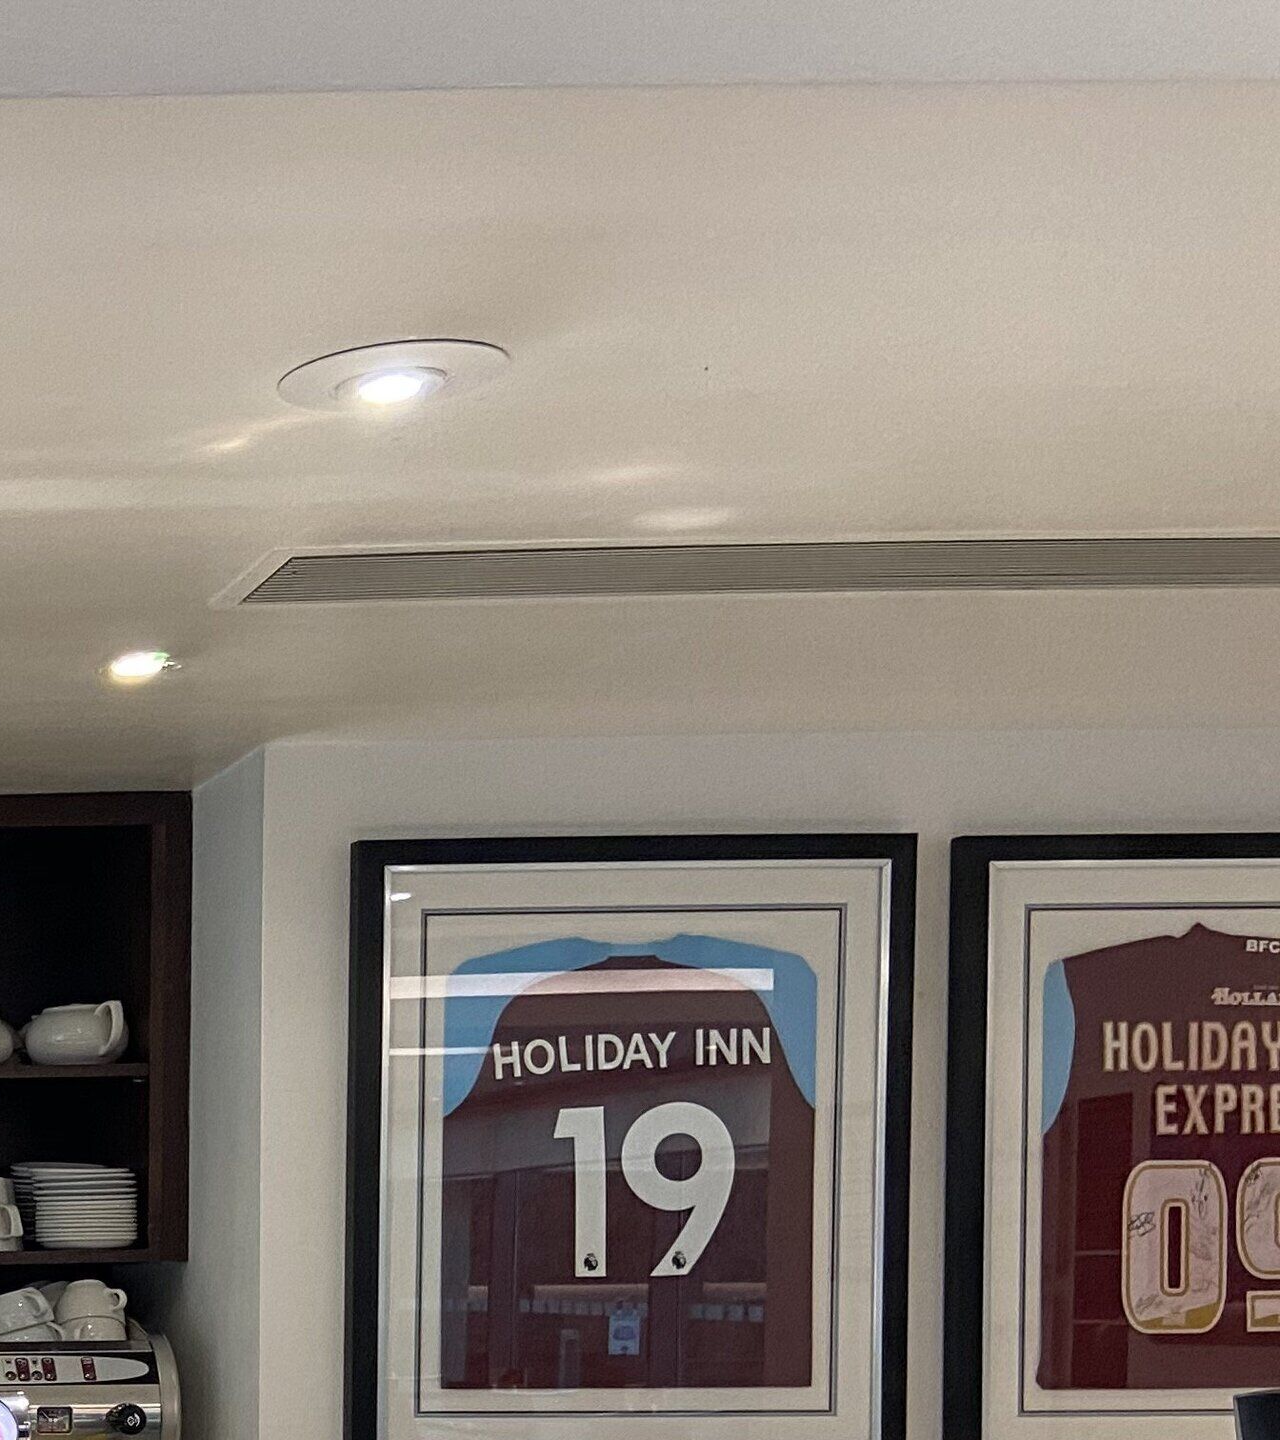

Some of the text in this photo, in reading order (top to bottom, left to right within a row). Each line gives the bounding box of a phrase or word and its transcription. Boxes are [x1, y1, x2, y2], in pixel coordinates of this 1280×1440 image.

[1245, 939, 1280, 954] BFC
[1211, 986, 1280, 1006] HOLLA
[492, 1027, 773, 1080] HOLIDAY INN
[1101, 1021, 1280, 1073] HOLIDAY
[553, 1101, 737, 1279] 19
